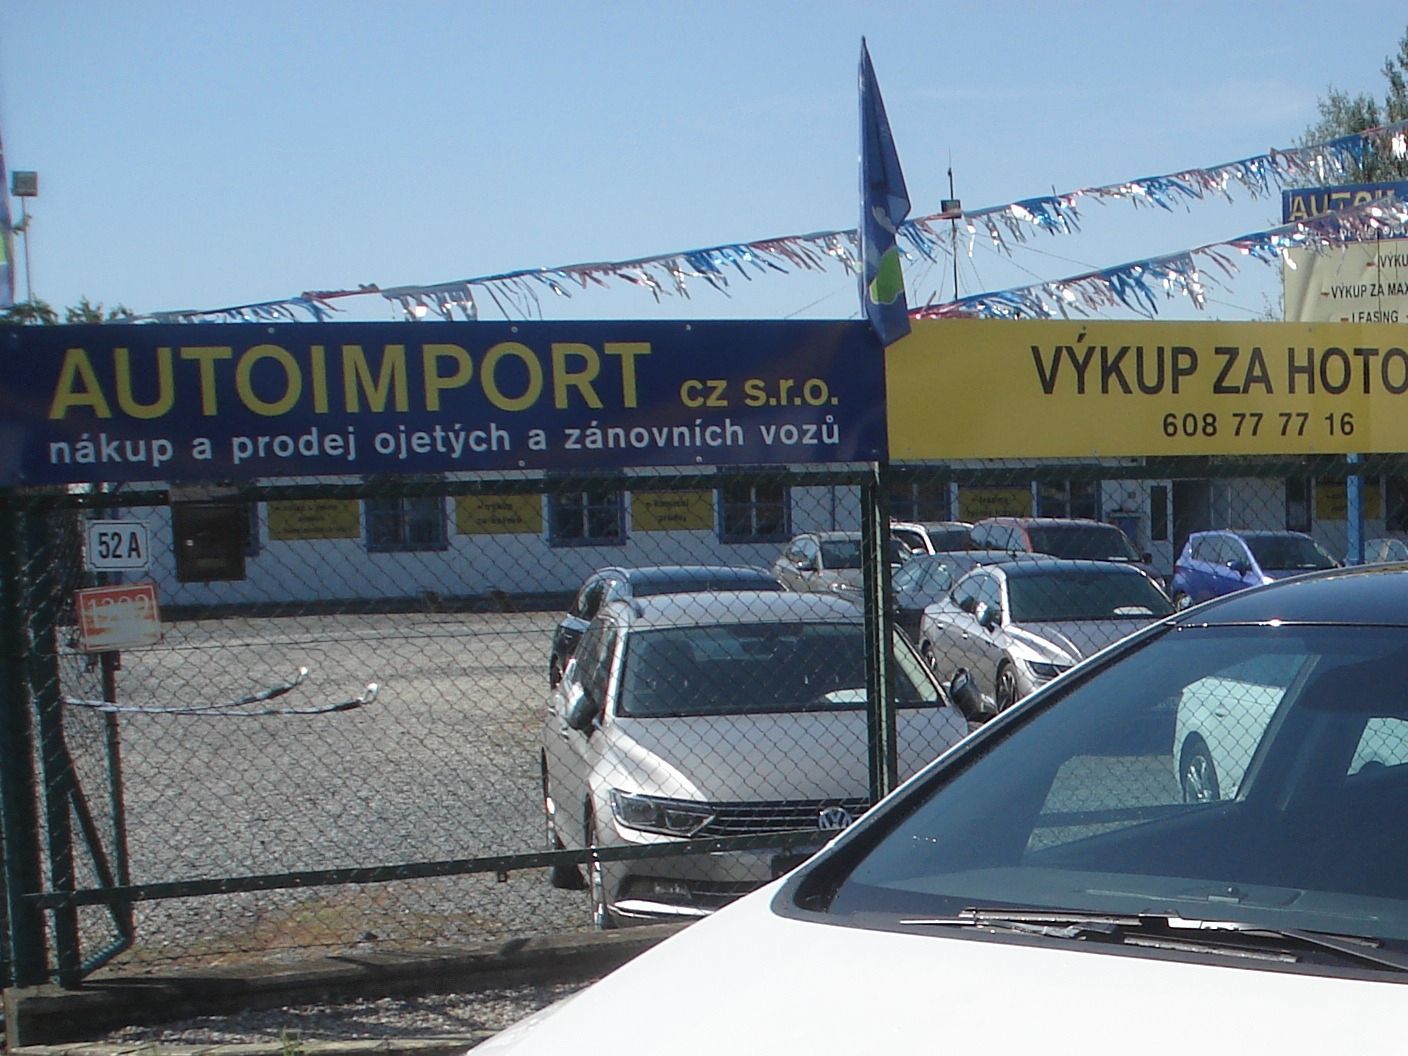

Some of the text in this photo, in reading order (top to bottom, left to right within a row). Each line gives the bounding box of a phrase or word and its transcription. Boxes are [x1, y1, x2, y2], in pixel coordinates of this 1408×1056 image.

[1370, 284, 1385, 297] ZA
[49, 341, 839, 420] AUTOIMPORT cz s.r.o.
[1030, 332, 1199, 395] VÝKUP
[1212, 347, 1274, 395] ZA
[49, 414, 840, 468] nákup a prodej ojetých a zánovních vozů
[1163, 412, 1355, 438] 608 77 77 16
